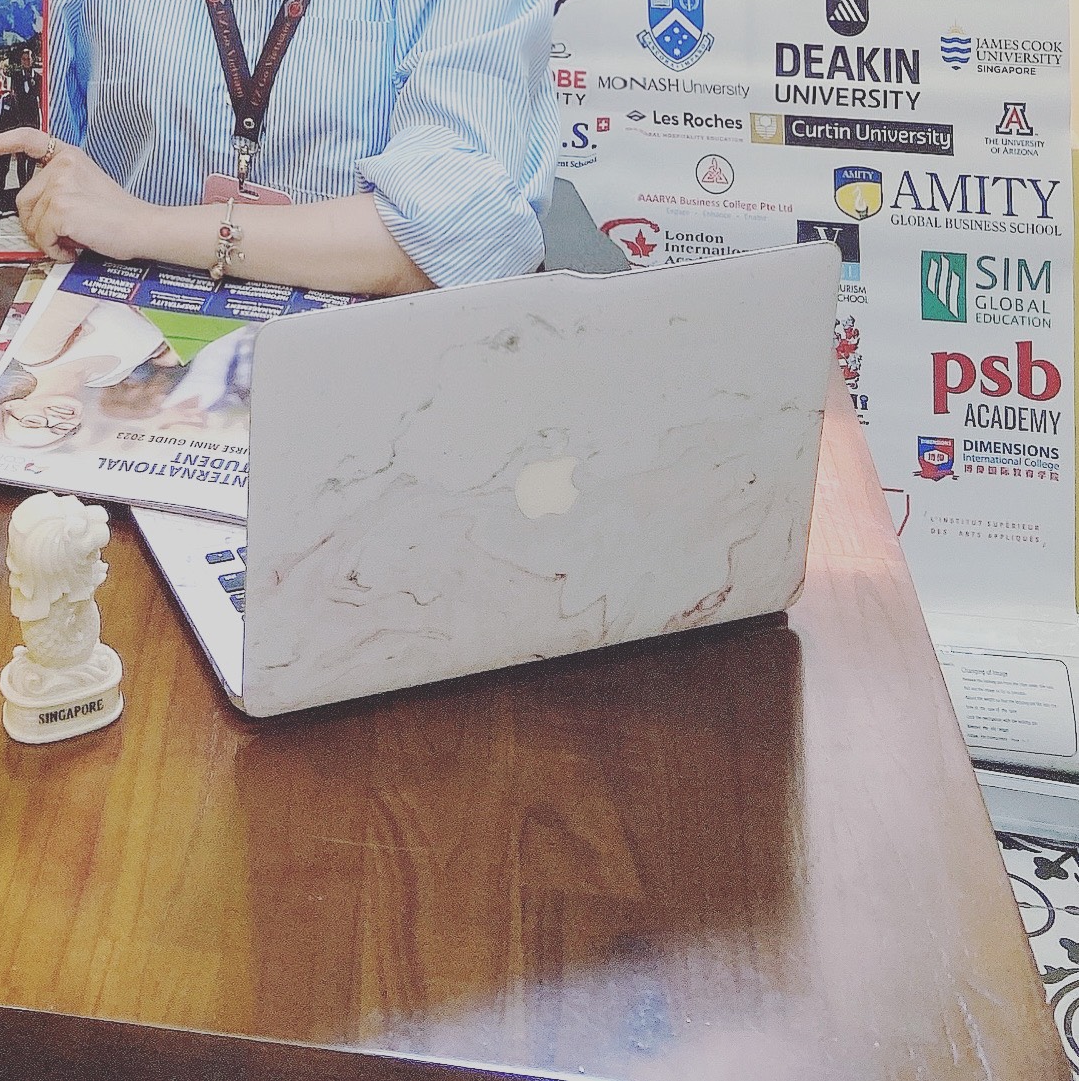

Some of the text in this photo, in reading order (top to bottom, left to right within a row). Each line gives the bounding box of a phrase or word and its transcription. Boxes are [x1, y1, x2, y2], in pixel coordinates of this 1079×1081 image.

[976, 38, 1063, 53] JAMES COOK
[775, 42, 921, 85] DEAKIN
[976, 52, 1063, 65] UNIVERSITY
[977, 65, 1036, 76] SINGAPORE
[598, 75, 680, 92] MONASH
[683, 79, 750, 99] University
[775, 83, 921, 111] UNIVERSITY
[653, 111, 743, 130] Les Roches
[791, 120, 951, 149] Curtin University
[985, 137, 1045, 149] THE UNIVERSITY
[1002, 148, 1039, 156] ARIZONA
[638, 194, 793, 213] AAARYA Business College Pte Ltd
[890, 170, 1061, 219] AMITY
[890, 214, 1062, 237] GLOBAL BUSINESS SCHOOL
[665, 230, 723, 243] London
[975, 255, 1052, 294] SIM
[975, 295, 1050, 315] GLOBAL
[975, 313, 1052, 329] EDUCATION
[931, 341, 1062, 415] psb
[964, 403, 1061, 435] ACADEMY
[117, 432, 219, 450] MINI GUIDE 2023
[963, 440, 1059, 459] DIMENSIONS
[98, 457, 248, 488] NTERNATIONAL
[171, 452, 249, 473] TUDENT
[963, 454, 1060, 471] International College
[39, 699, 104, 724] SINGAPORE
